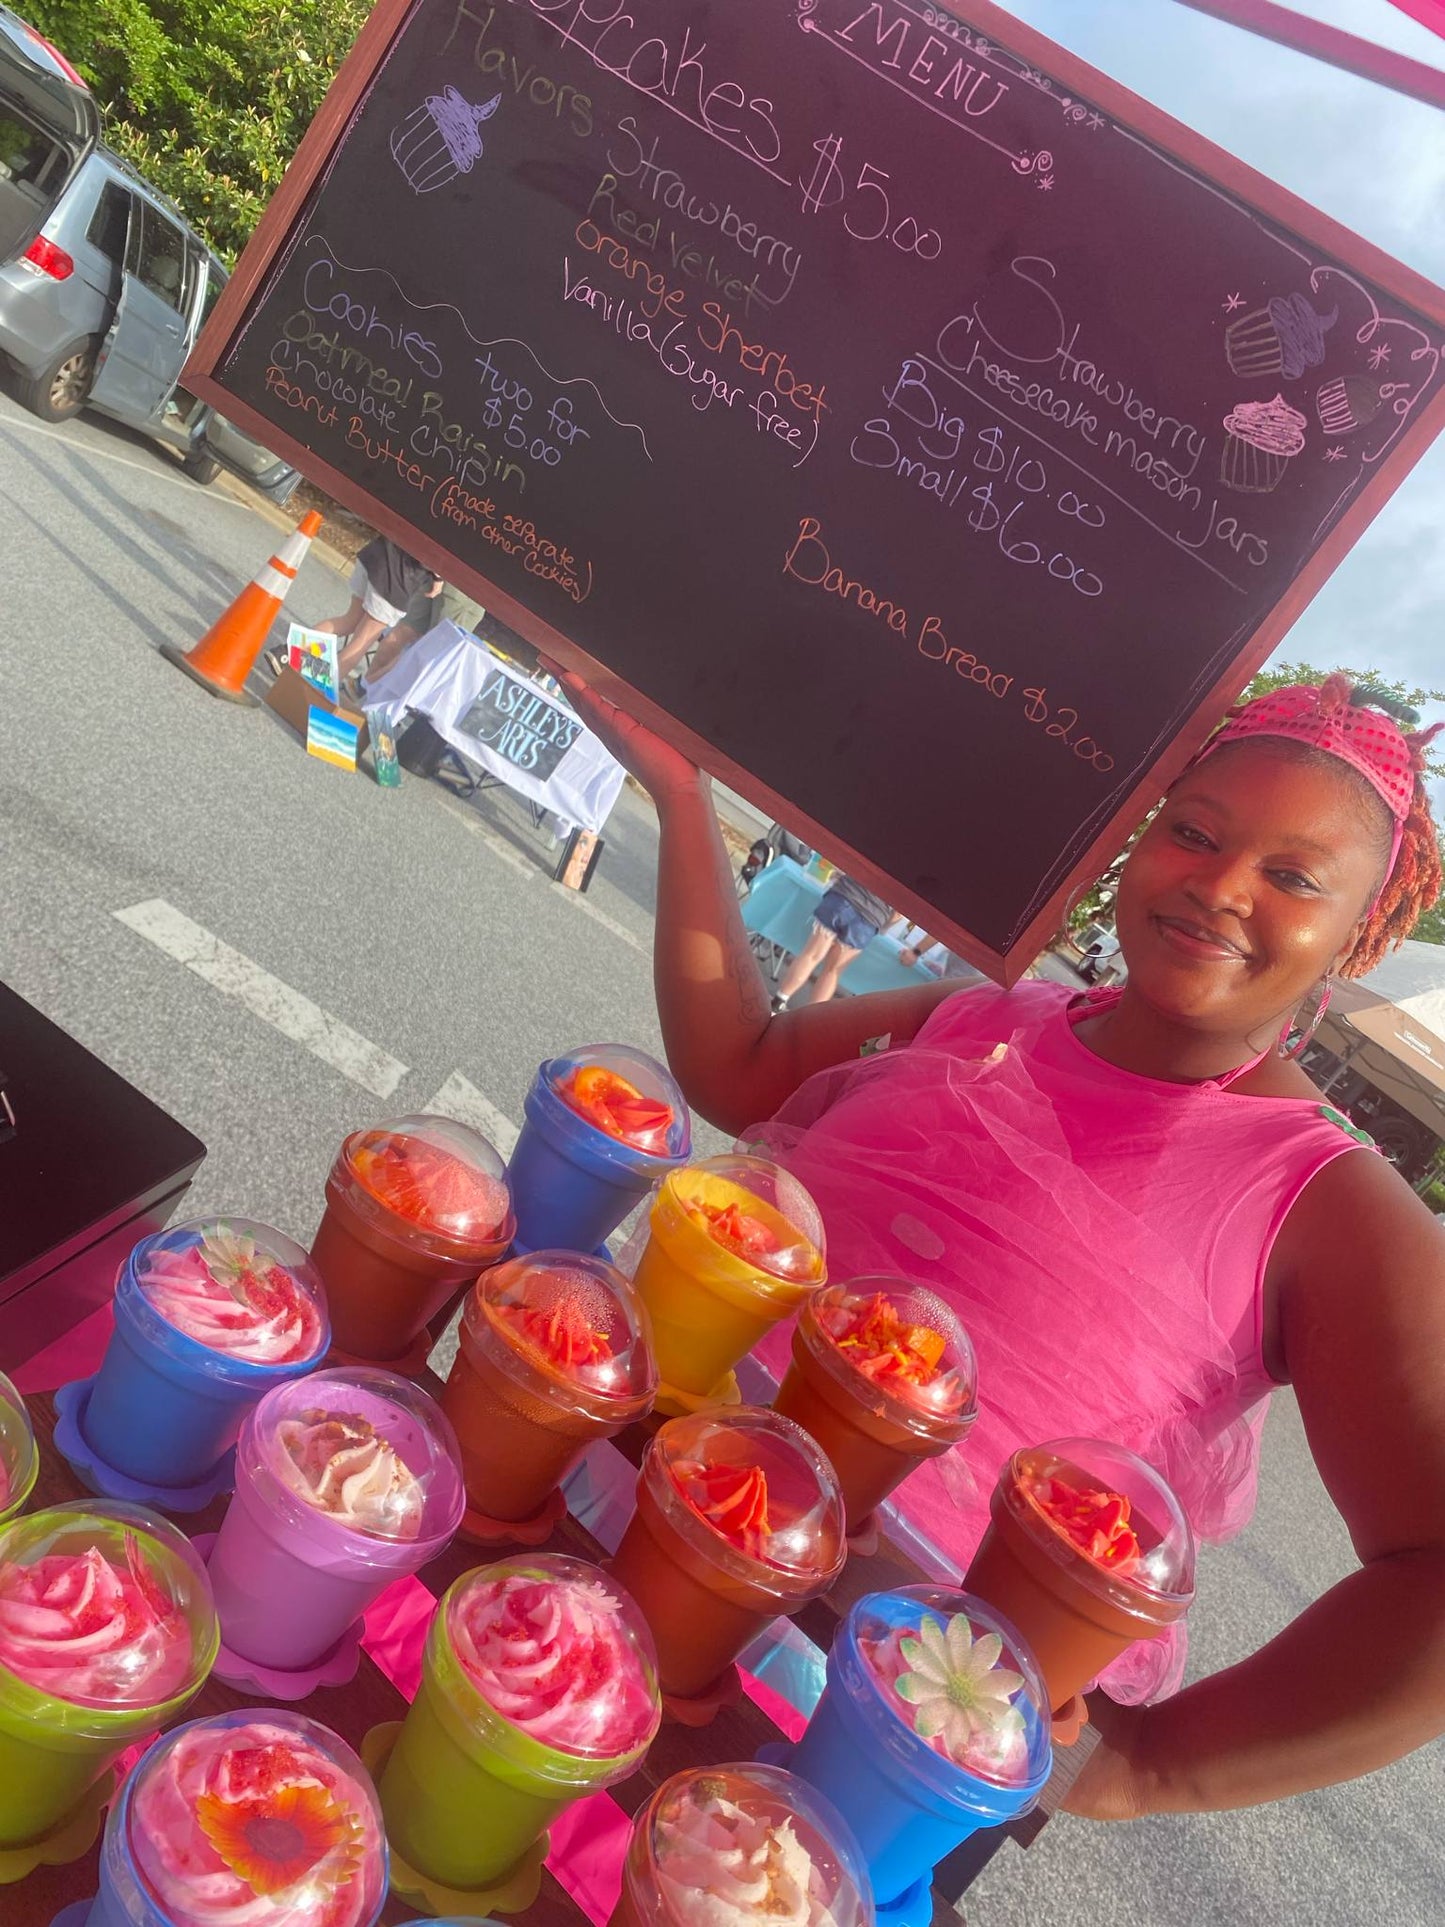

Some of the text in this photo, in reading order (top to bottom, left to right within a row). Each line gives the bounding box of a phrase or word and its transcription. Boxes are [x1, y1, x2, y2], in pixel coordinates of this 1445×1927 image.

[834, 2, 1009, 116] MENU
[588, 173, 661, 250] Red
[606, 116, 802, 305] Strawberry
[798, 132, 942, 260] $5.00
[270, 338, 400, 434] Chocolate
[281, 310, 527, 495] Oatmeal Raisin
[303, 258, 592, 446] Cookies two for
[697, 302, 832, 424] Sherbet
[972, 255, 1207, 478] Strawberry
[264, 365, 340, 428] Peanut
[344, 416, 436, 492] Butter
[748, 390, 820, 469] free)
[882, 359, 1106, 528] Big $10.00
[1104, 429, 1202, 511] mason
[441, 497, 477, 531] from
[481, 524, 526, 556] other
[850, 418, 1104, 597] Small $6.00
[782, 517, 1115, 771] Banana Bread $2.00
[478, 674, 583, 749] ASHLEY'S
[478, 718, 549, 770] ARTS
